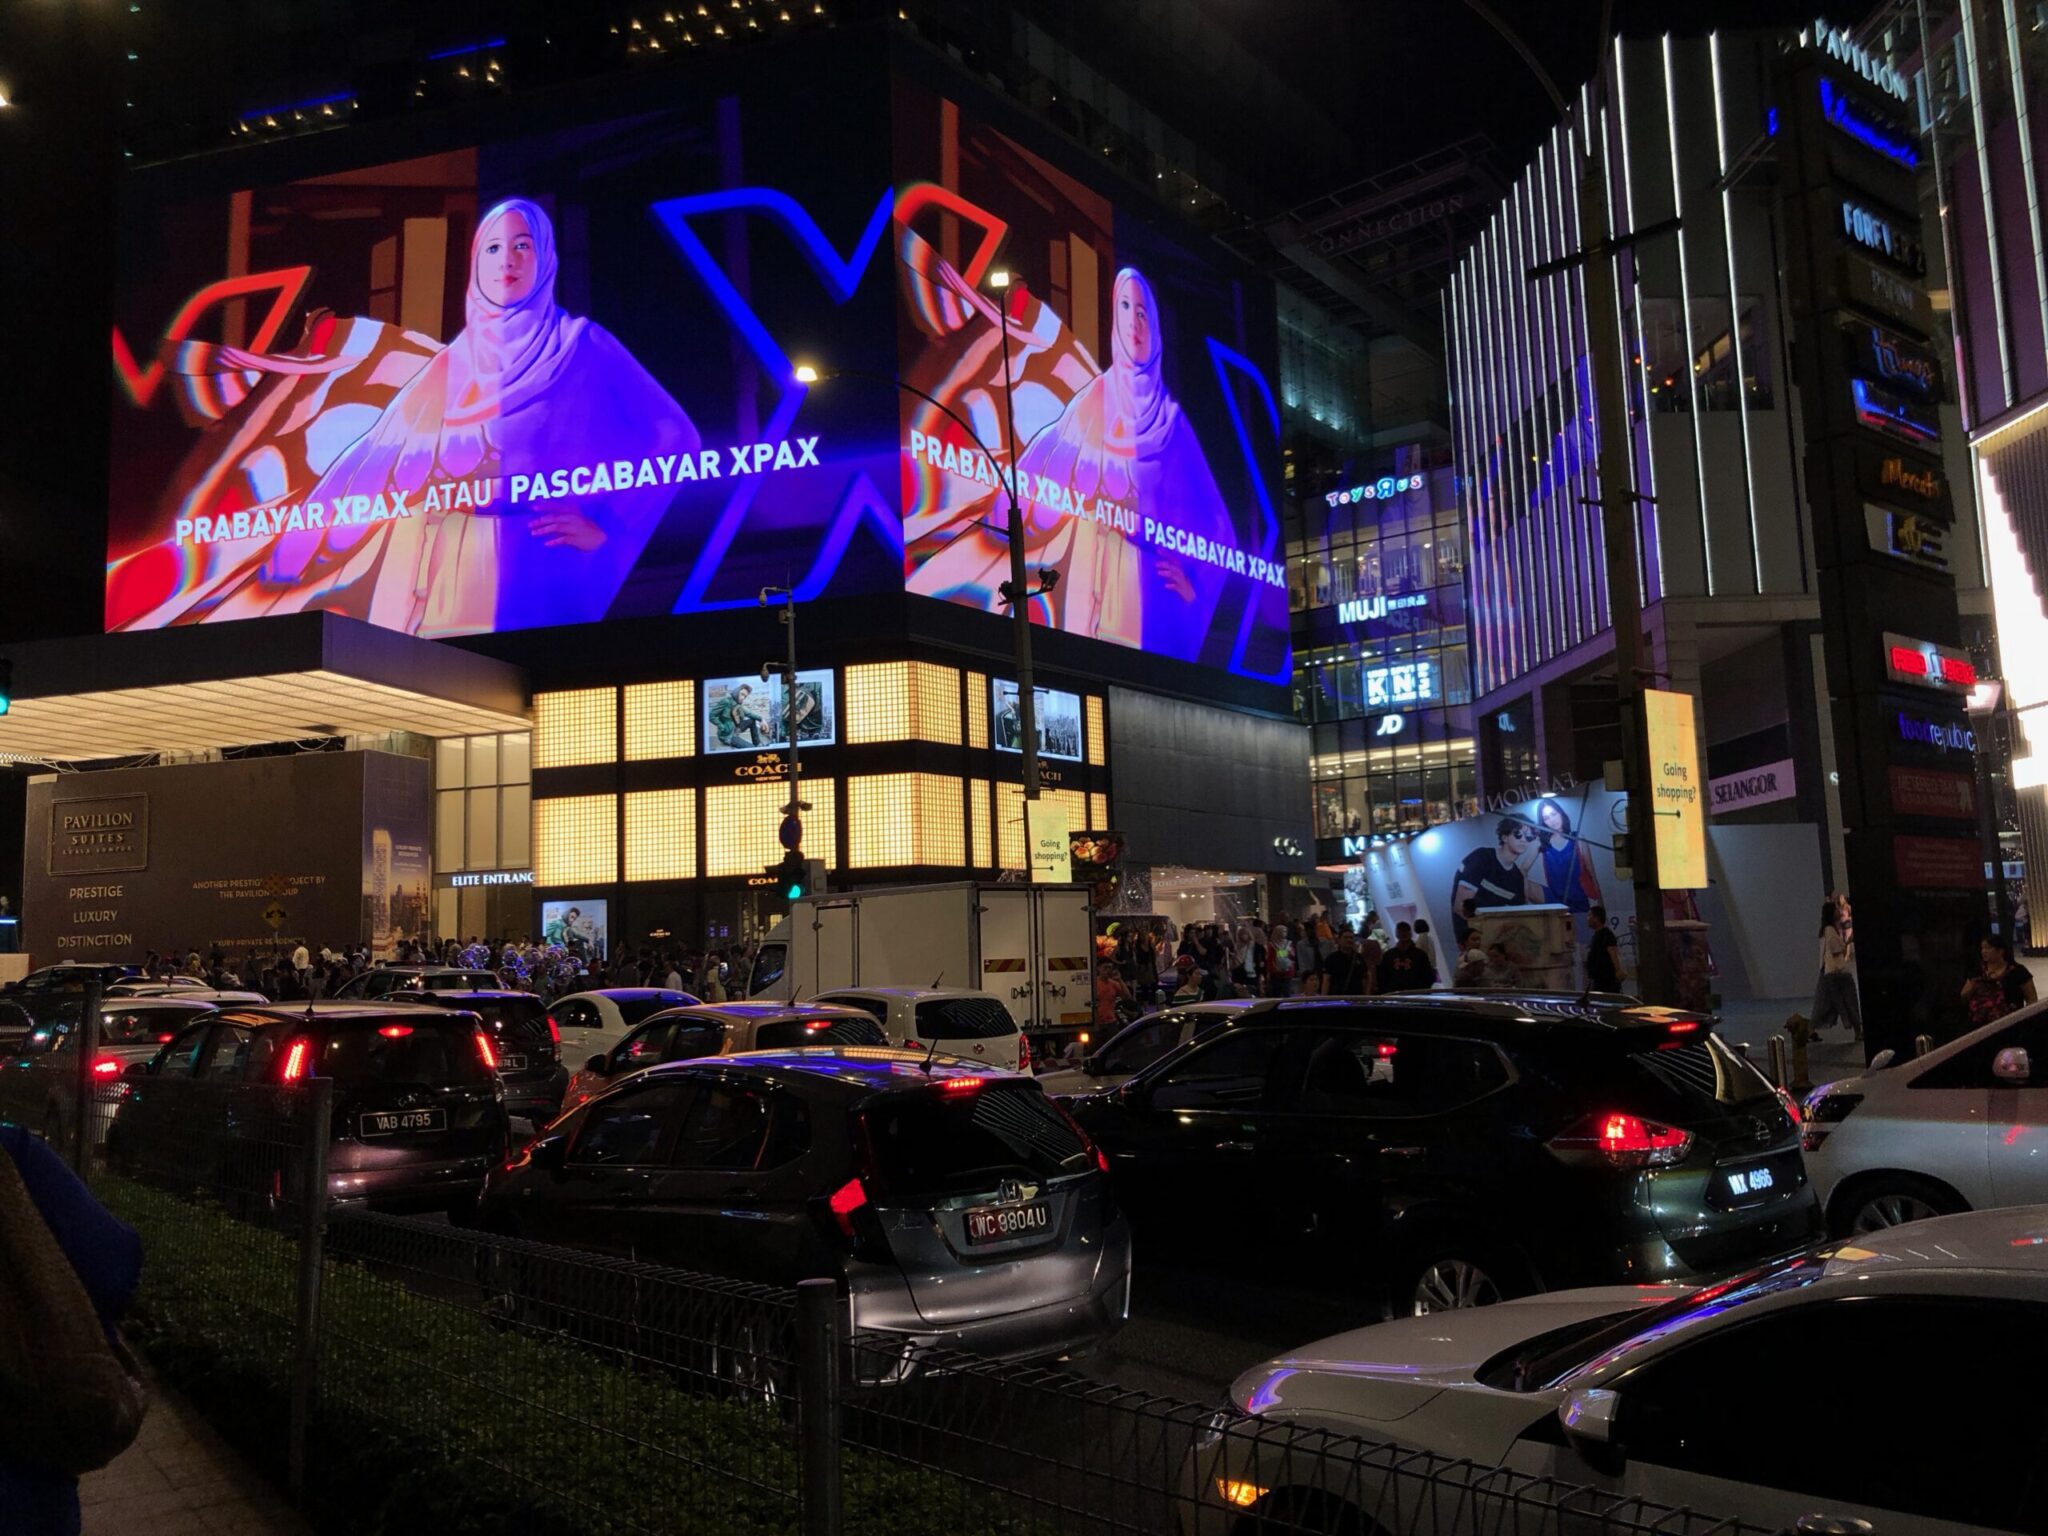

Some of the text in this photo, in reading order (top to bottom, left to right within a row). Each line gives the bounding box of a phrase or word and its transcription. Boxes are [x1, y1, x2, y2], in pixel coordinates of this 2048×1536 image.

[175, 435, 820, 546] PRABAYAR XPAX ATAU PASCABAYAR XPAX
[911, 429, 1286, 589] PRABAYAR XPAX ATAU PASCABAYAR XPAX
[1339, 595, 1387, 624] MUJI
[1376, 714, 1403, 736] JD
[1897, 711, 1977, 754] foodrepubic
[1663, 762, 1688, 781] Going
[1656, 783, 1697, 804] shopping?
[1714, 772, 1778, 805] SELANGOR
[64, 812, 133, 829] PAVILION
[71, 832, 125, 845] SUITES
[1040, 839, 1061, 850] Going
[1034, 851, 1068, 862] shopping?
[192, 879, 228, 889] ANOTHER
[230, 878, 263, 888] PRESTIG
[316, 875, 326, 884] BY
[452, 874, 481, 887] ELITE
[69, 885, 124, 899] PRESTIGE
[219, 890, 234, 898] THE
[235, 889, 270, 898] PAVILION
[73, 909, 118, 924] LUXURY
[57, 933, 133, 948] DISTINCTION
[376, 1113, 432, 1130] VAB 4795
[976, 1215, 997, 1236] WC
